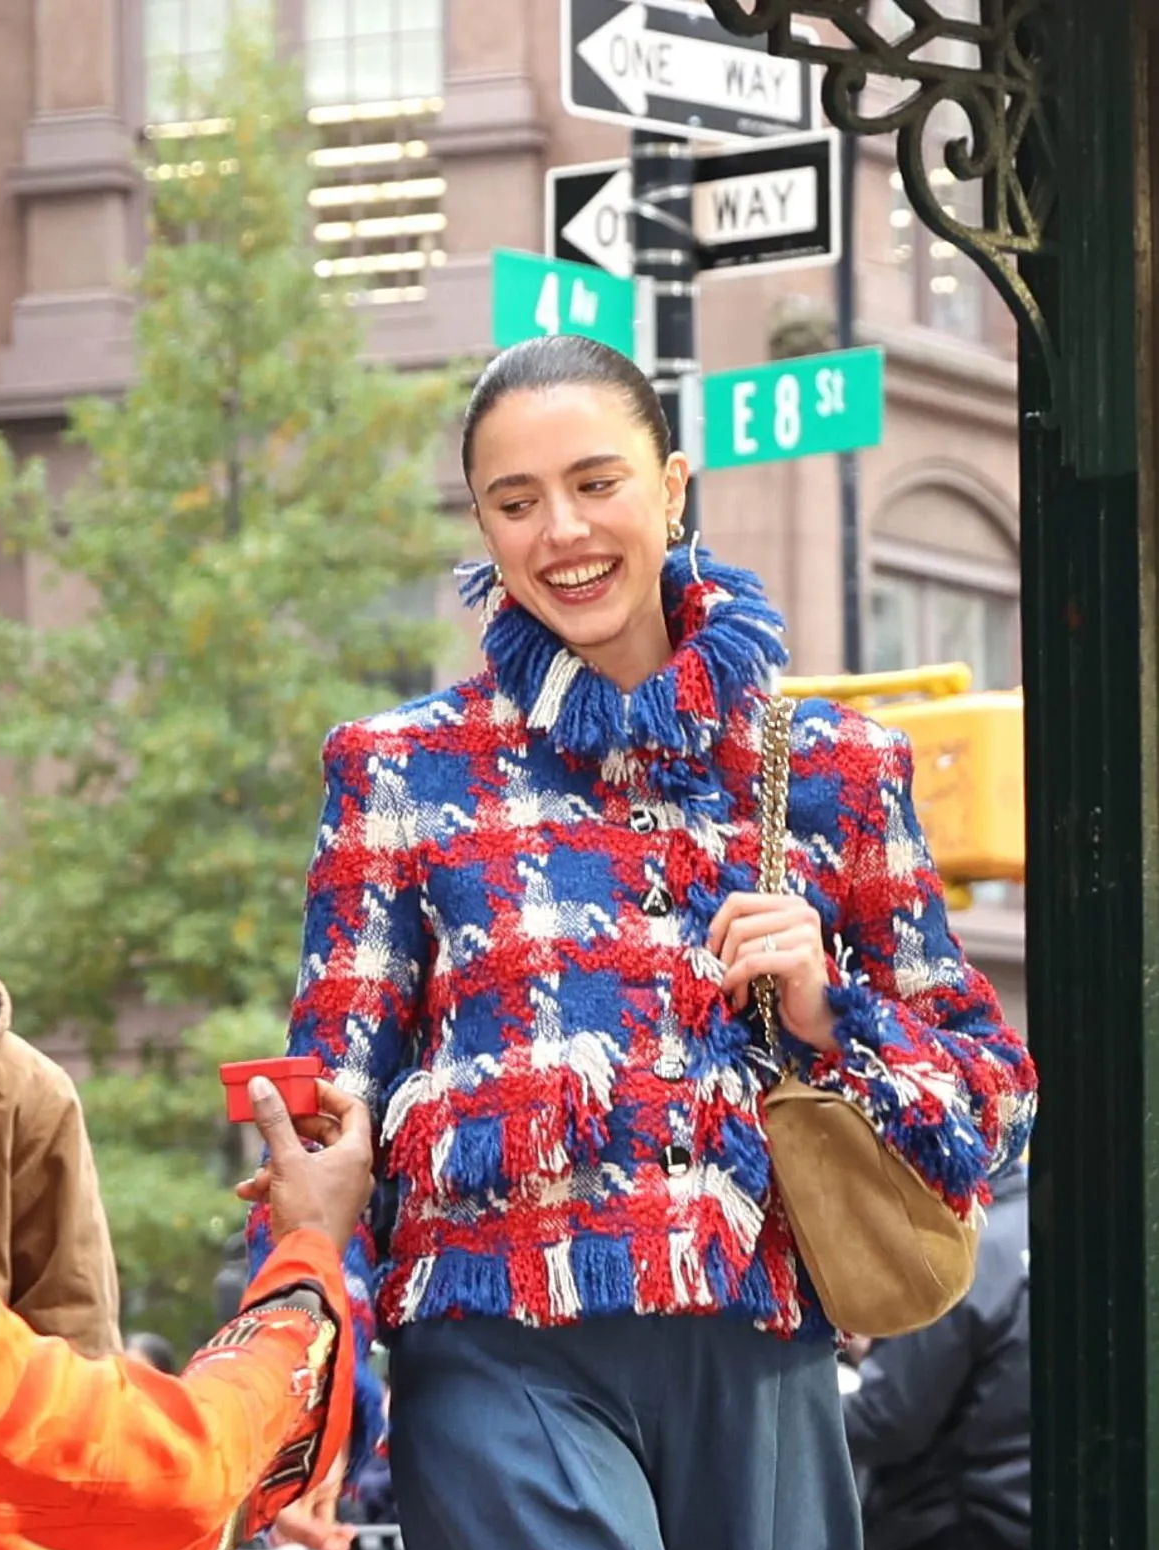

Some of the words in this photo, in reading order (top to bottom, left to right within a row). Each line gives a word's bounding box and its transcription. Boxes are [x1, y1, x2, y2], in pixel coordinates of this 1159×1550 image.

[610, 34, 673, 86] ONE
[723, 58, 788, 104] WAY
[711, 181, 795, 231] WAY
[535, 271, 559, 335] 4
[733, 381, 758, 455] E
[774, 373, 801, 451] 8
